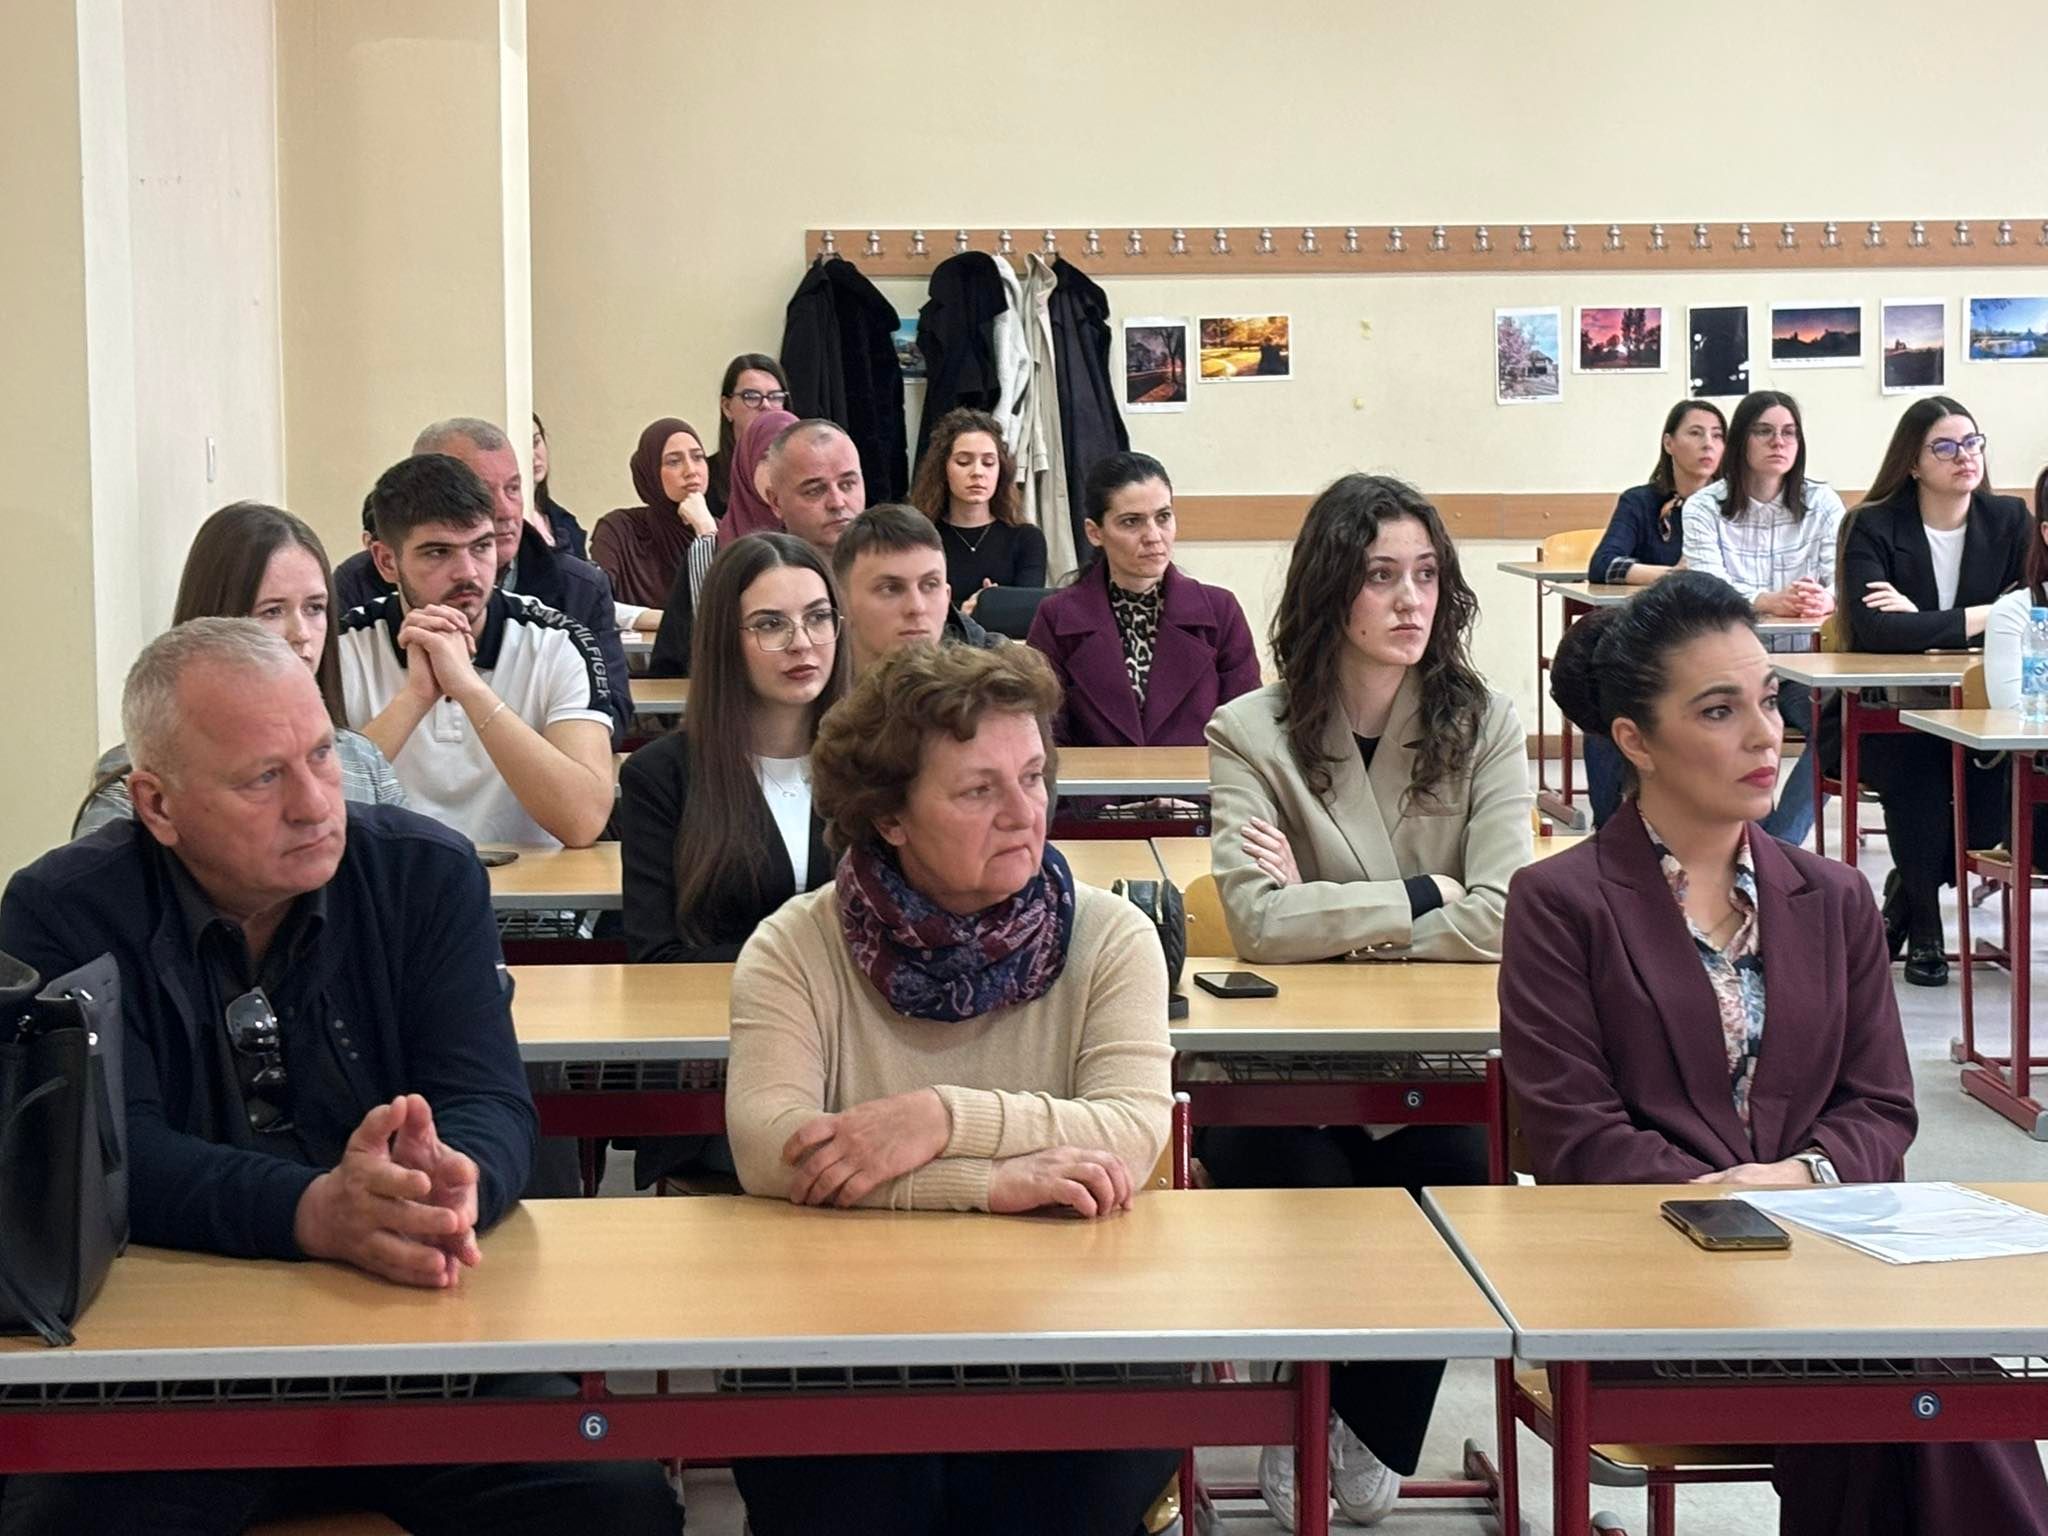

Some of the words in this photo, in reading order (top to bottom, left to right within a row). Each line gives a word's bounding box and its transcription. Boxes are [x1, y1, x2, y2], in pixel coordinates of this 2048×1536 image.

[1196, 825, 1205, 836] 6
[1408, 1091, 1419, 1106] 6
[1918, 1395, 1934, 1415] 6
[586, 1415, 601, 1436] 6
